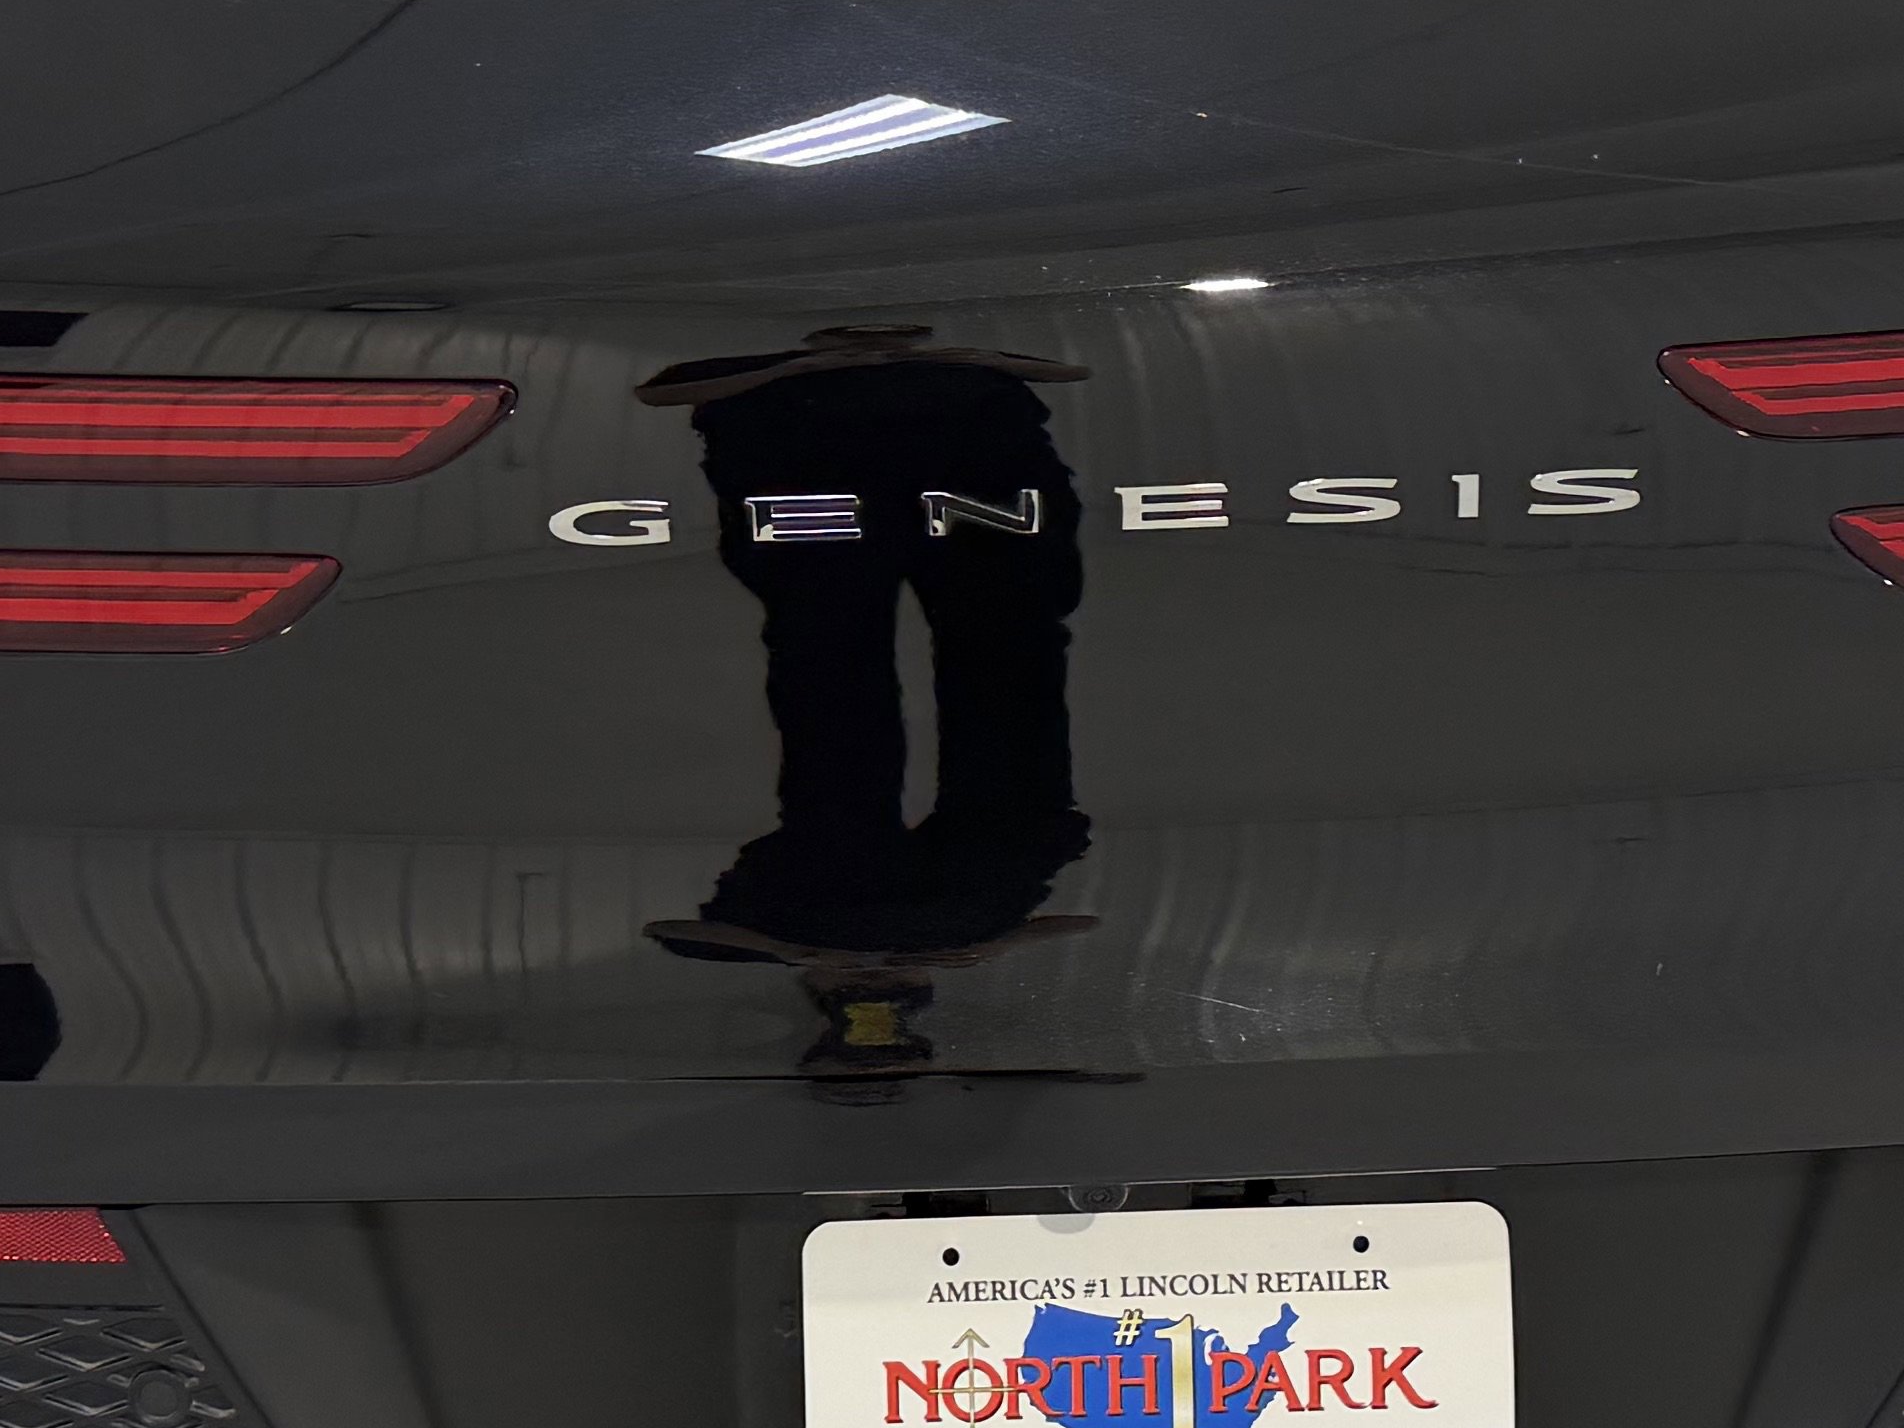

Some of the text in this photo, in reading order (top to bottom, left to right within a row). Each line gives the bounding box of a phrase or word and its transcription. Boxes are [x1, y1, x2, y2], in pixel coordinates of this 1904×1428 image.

[547, 467, 1640, 547] GENESIS
[926, 1269, 1391, 1304] AMERICA'S #1 LINCOLN RETAILER
[881, 1345, 1441, 1425] NORTH PARK
